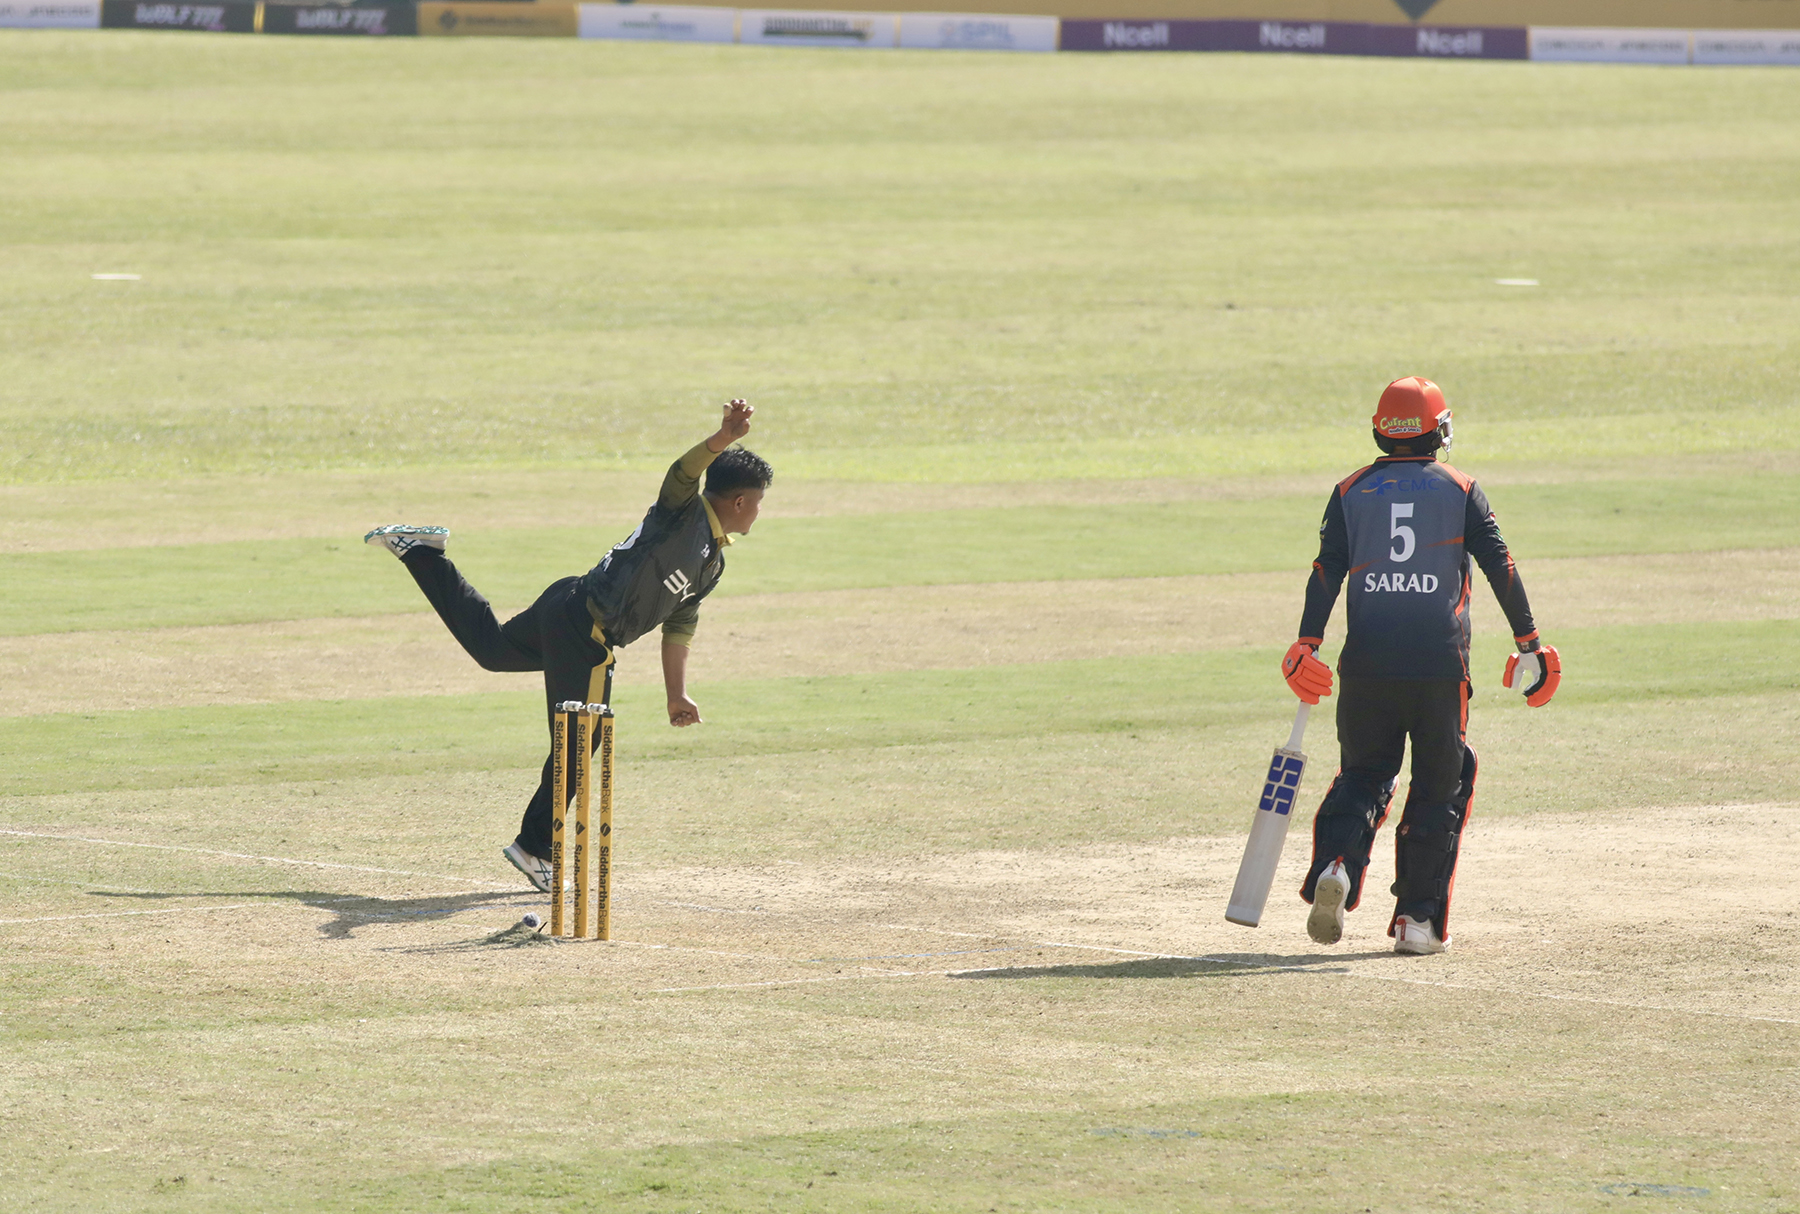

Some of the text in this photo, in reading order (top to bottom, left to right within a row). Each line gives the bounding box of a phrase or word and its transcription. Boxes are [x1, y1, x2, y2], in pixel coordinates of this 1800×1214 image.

[1103, 21, 1169, 47] Ncell
[1259, 21, 1326, 47] Ncell
[1416, 28, 1483, 54] Ncell
[1380, 416, 1422, 430] Current
[1397, 478, 1440, 491] CMC
[1389, 502, 1416, 562] 5
[1364, 572, 1439, 593] SARAD
